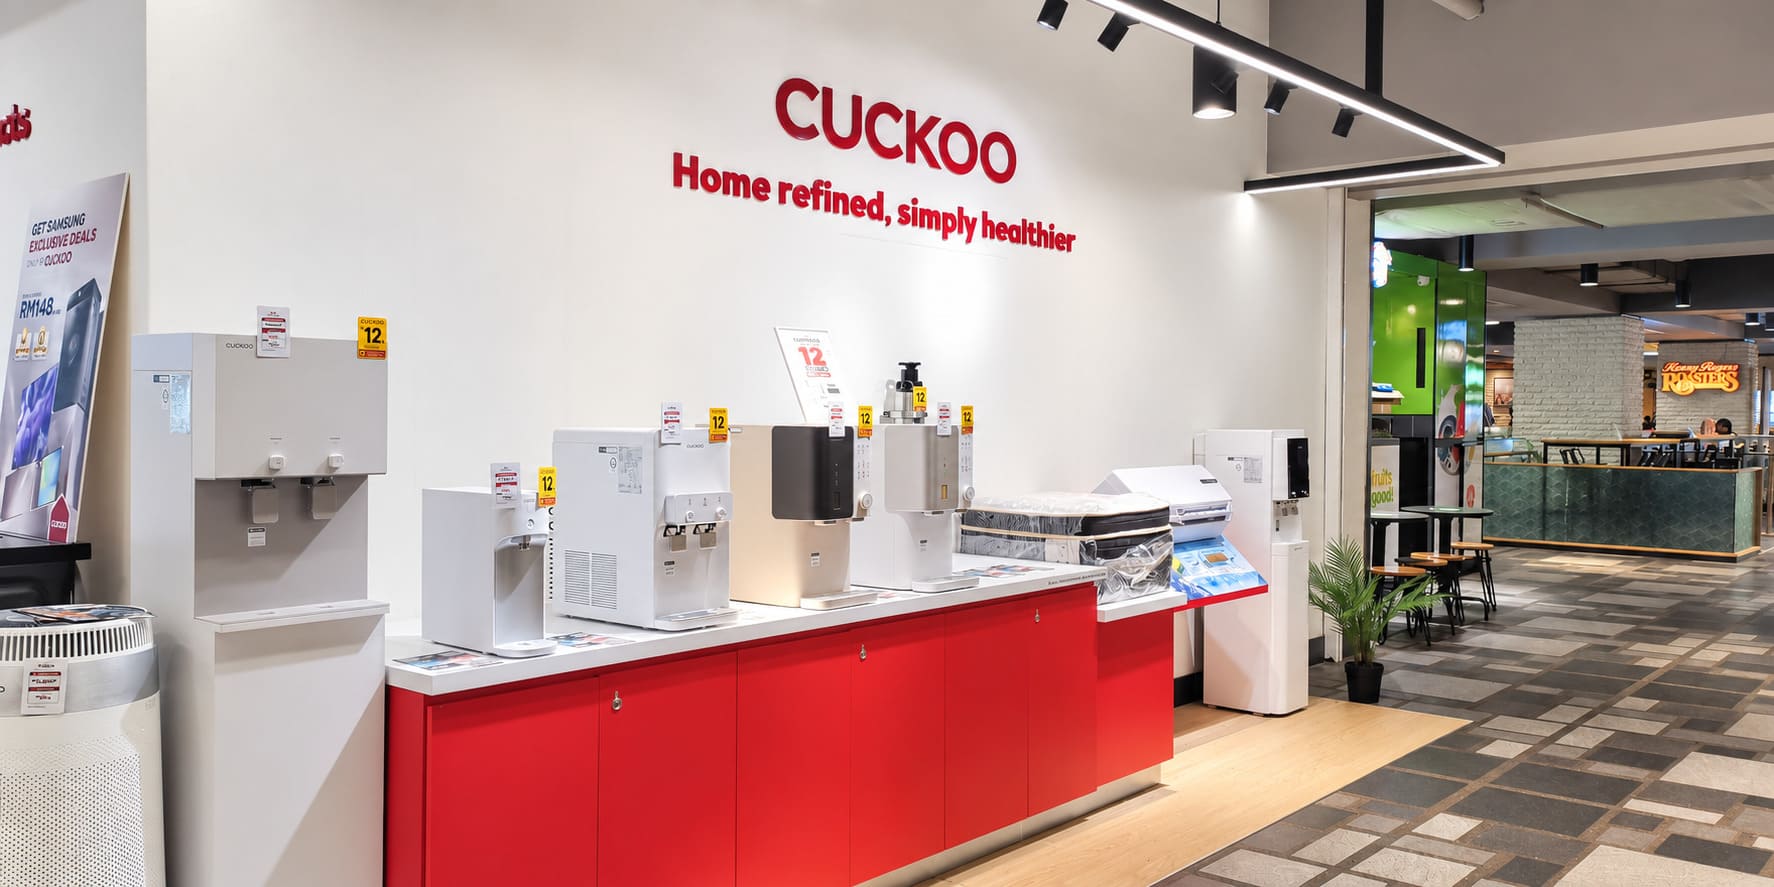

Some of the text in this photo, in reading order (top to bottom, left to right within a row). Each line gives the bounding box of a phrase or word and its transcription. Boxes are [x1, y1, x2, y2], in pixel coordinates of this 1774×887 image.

[775, 77, 1017, 184] CUCKOO
[672, 151, 1076, 253] Home refined, simply healthier
[31, 213, 86, 236] GET SAMSUNG
[29, 228, 97, 253] EXCLUSIVE DEALS
[44, 251, 72, 266] CUCKOO
[20, 297, 54, 319] RM148
[798, 346, 827, 366] 12
[916, 392, 925, 402] 12
[713, 415, 725, 430] 12
[861, 412, 870, 425] 12
[963, 411, 972, 422] 12
[542, 475, 553, 492] 12
